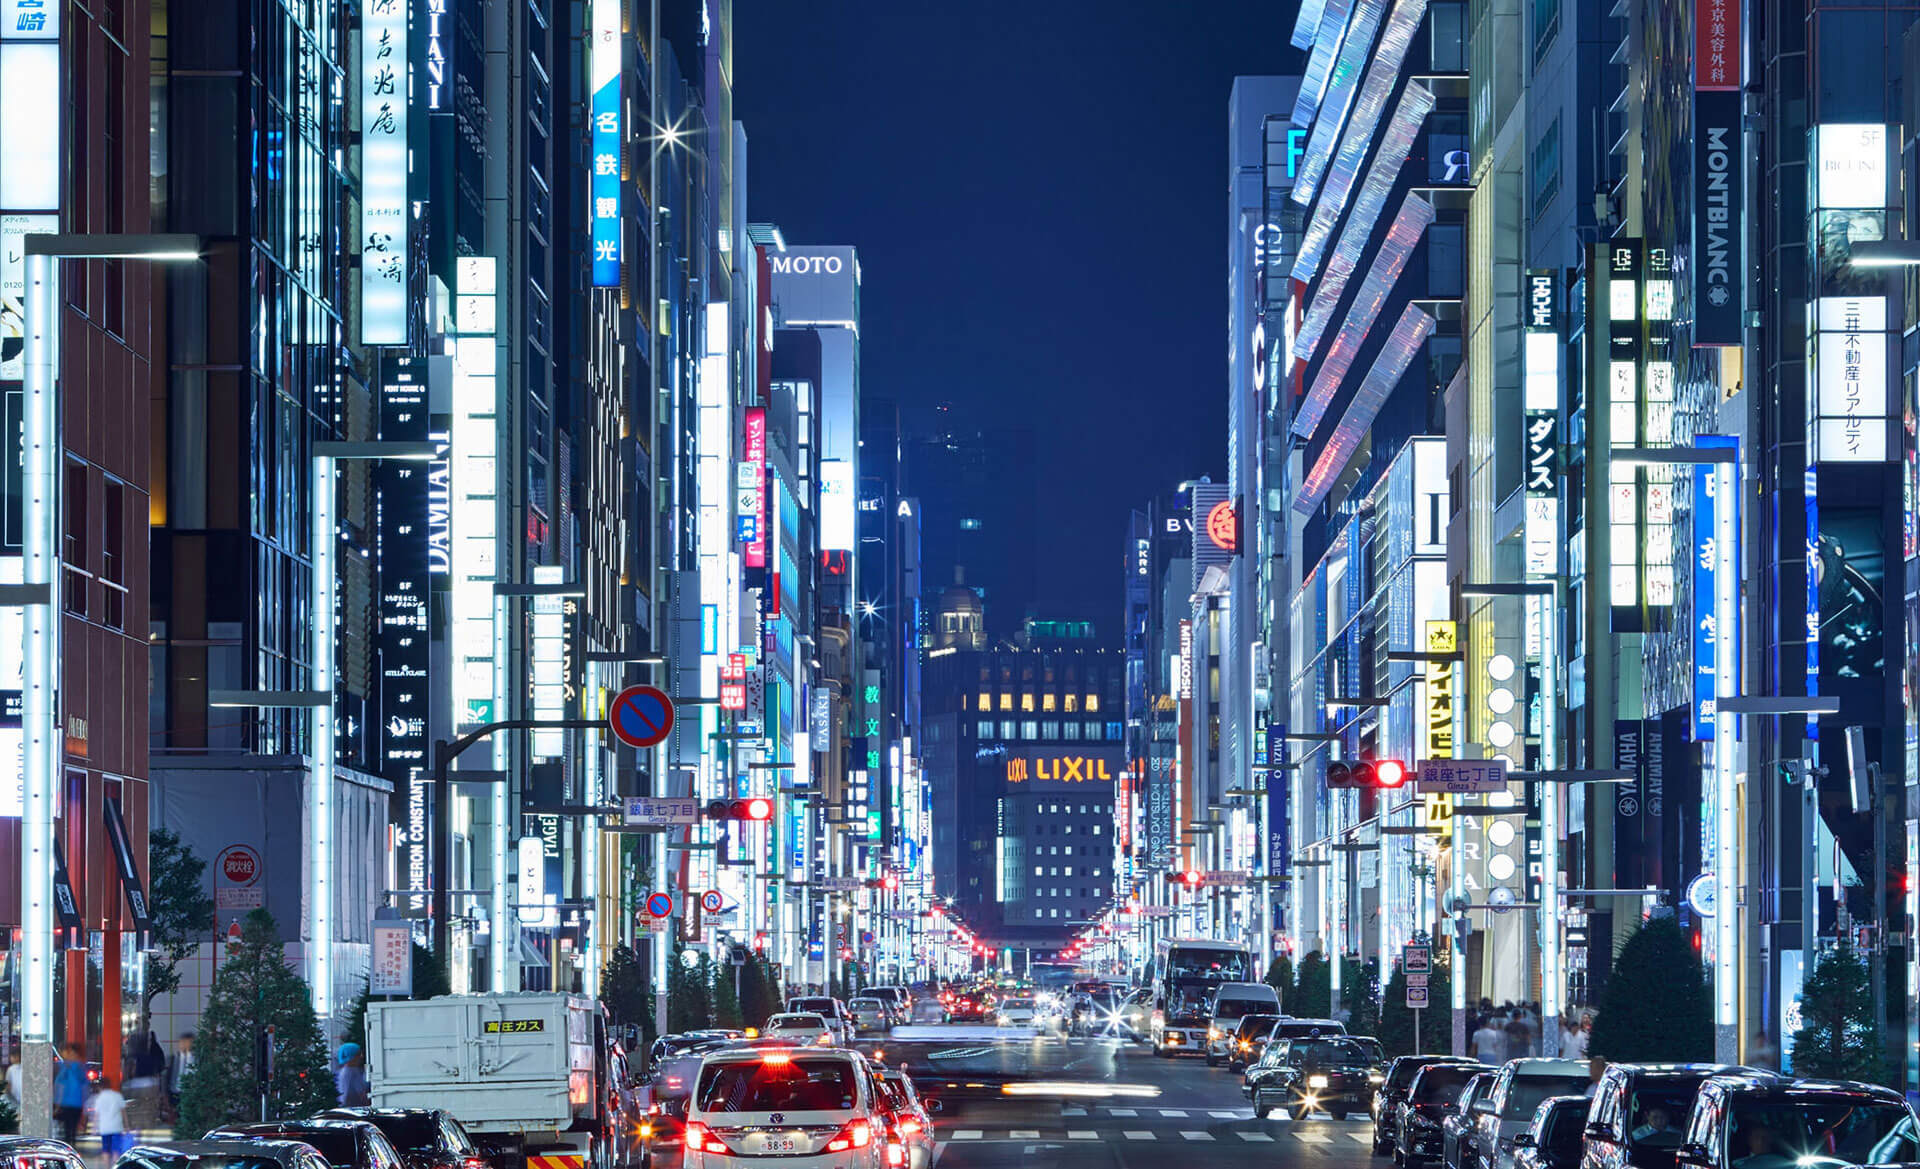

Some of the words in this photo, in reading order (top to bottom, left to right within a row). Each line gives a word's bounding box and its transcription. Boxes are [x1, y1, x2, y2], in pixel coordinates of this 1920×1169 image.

[596, 112, 617, 262] 名鉄観光
[1708, 128, 1728, 284] MONTBLANC
[772, 256, 842, 274] MOTO
[1845, 302, 1860, 455] 三井不動産リアルティ
[1529, 417, 1554, 489] ダンス
[1180, 625, 1190, 699] MITSUKOSHI
[722, 687, 742, 697] UNI
[722, 698, 743, 709] QLO
[818, 695, 828, 745] TASAKI
[1008, 757, 1028, 783] LIXIL
[1036, 756, 1112, 783] LIXIL
[1273, 738, 1283, 779] MIZUO
[1424, 768, 1501, 783] 銀座七丁目
[1447, 783, 1470, 791] Ginza
[630, 804, 693, 816] 銀座七丁目
[226, 861, 253, 872] 消火栓
[488, 1021, 540, 1032] 高圧ガス
